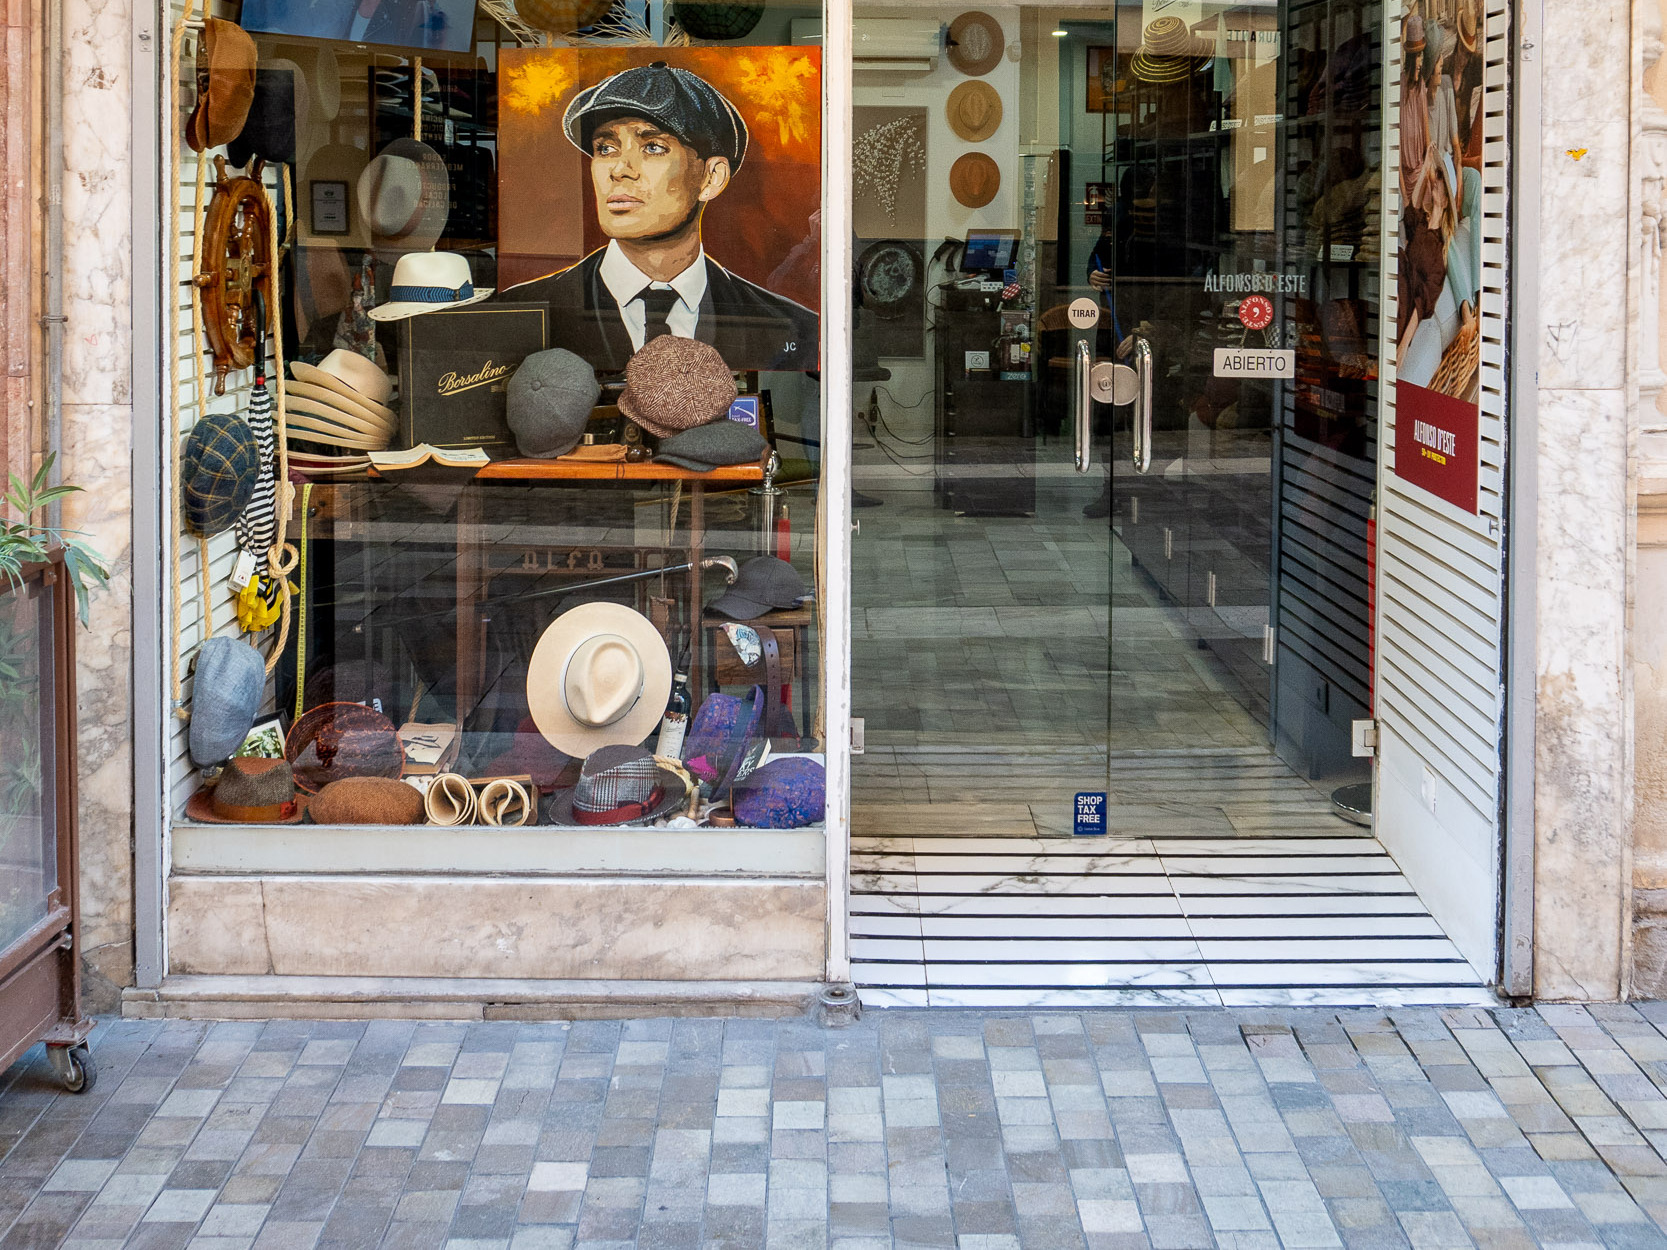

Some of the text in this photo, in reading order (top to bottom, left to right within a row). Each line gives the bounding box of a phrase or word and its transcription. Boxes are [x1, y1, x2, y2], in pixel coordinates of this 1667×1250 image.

[1204, 273, 1260, 292] ALFONSO
[1240, 297, 1272, 314] ALFONSO
[1072, 309, 1096, 318] TIRAR
[784, 342, 797, 352] JC
[1223, 356, 1286, 371] ABIERTO
[437, 360, 518, 396] Borsalino
[1077, 796, 1103, 805] SHOP
[1077, 805, 1096, 814] TAX
[1077, 814, 1100, 823] FREE
